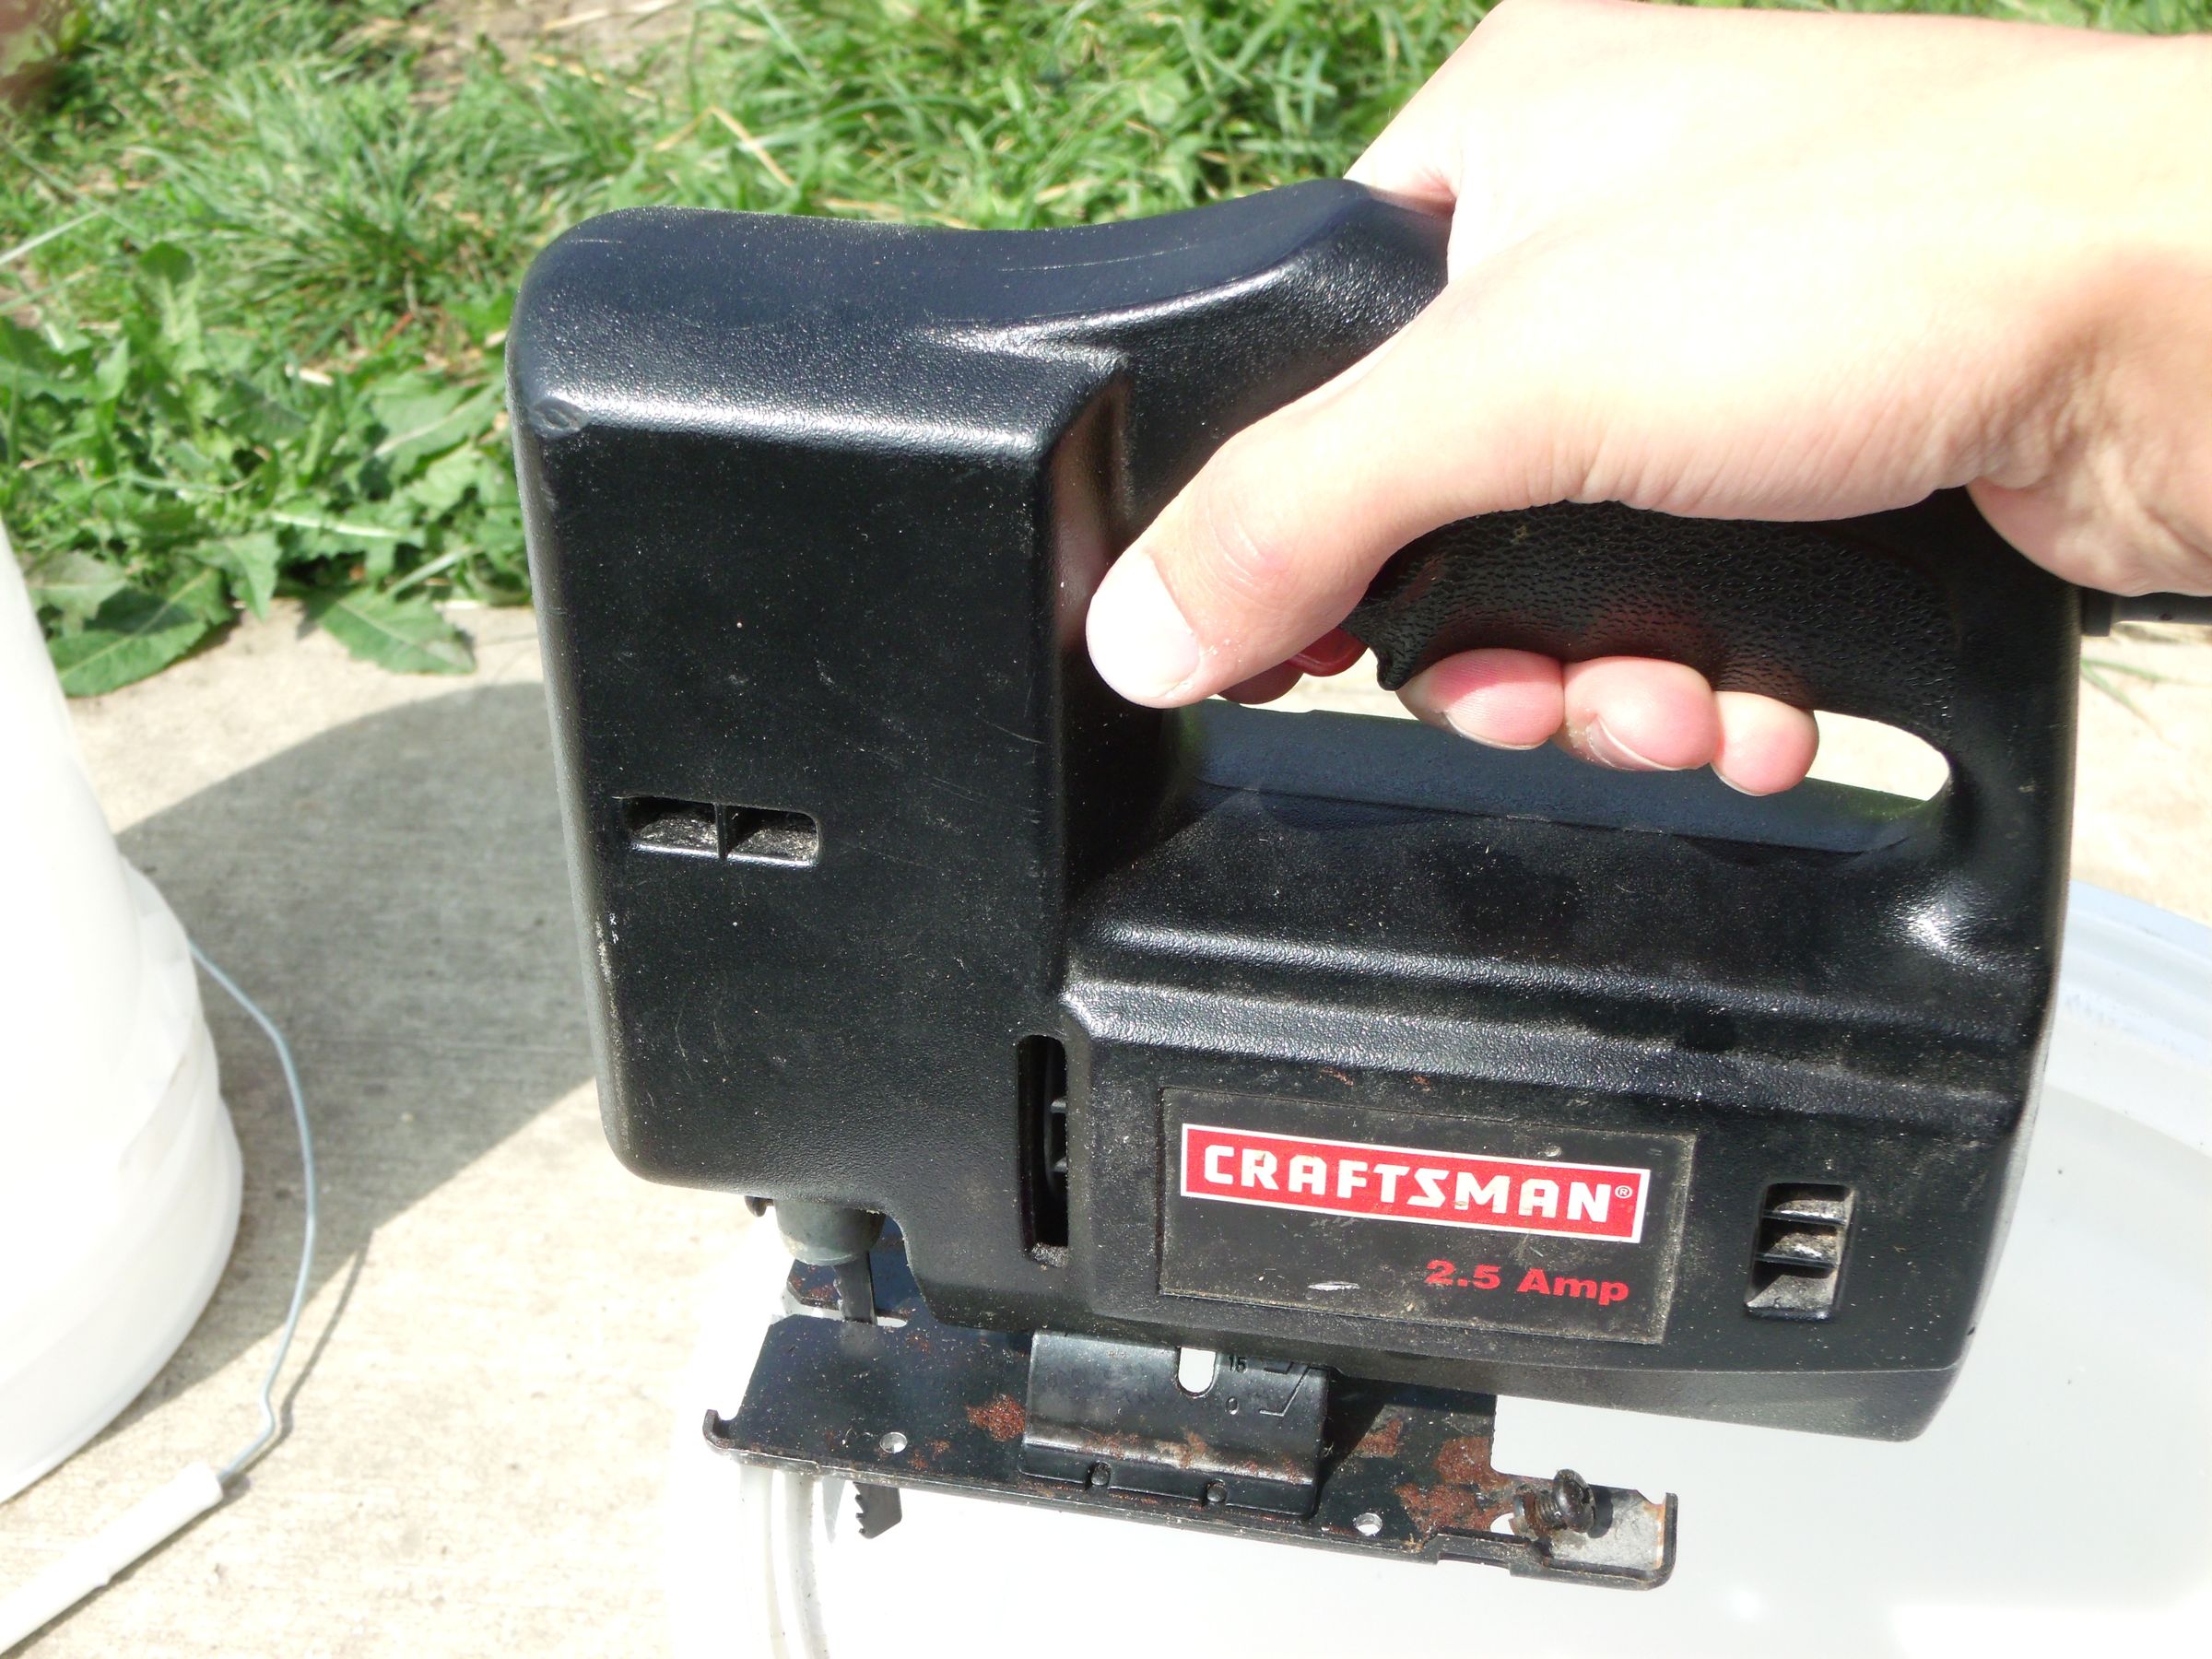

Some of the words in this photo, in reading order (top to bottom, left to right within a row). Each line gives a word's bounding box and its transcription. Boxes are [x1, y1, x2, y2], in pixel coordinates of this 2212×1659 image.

[1426, 1260, 1500, 1290] 2.5
[1516, 1268, 1630, 1305] Amp
[1229, 1354, 1247, 1372] 15
